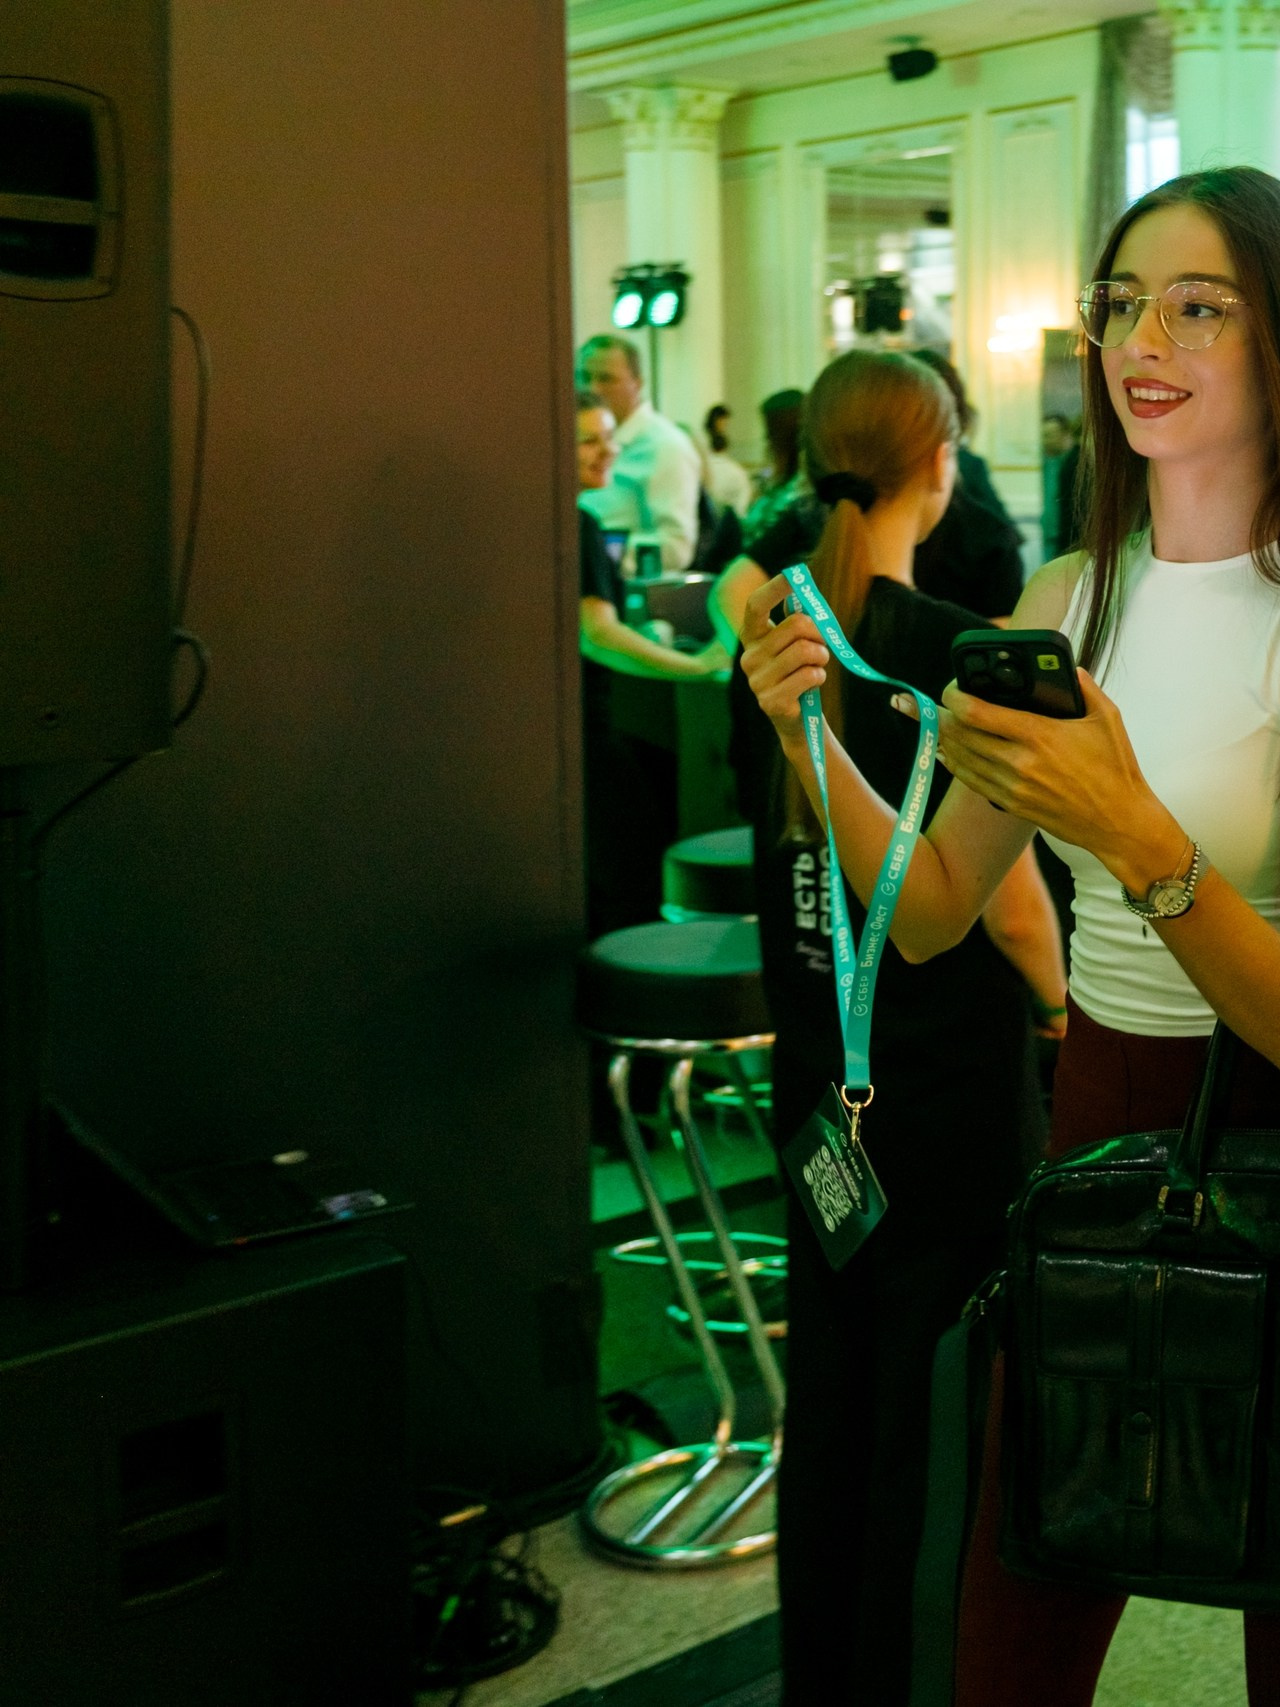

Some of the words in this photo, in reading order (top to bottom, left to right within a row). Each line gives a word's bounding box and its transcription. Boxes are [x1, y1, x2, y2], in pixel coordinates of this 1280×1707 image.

[801, 585, 830, 621] Бизнес
[826, 626, 846, 651] СБЕР
[807, 715, 819, 763] Бизнес
[900, 773, 928, 834] Бизнес
[919, 729, 936, 770] Фест
[888, 844, 905, 881] СБЕР
[792, 852, 817, 930] ЕСТЬ
[870, 905, 889, 931] Фест
[836, 927, 850, 963] Фест
[861, 929, 880, 968] Бизнес
[858, 975, 870, 1002] СБЕР
